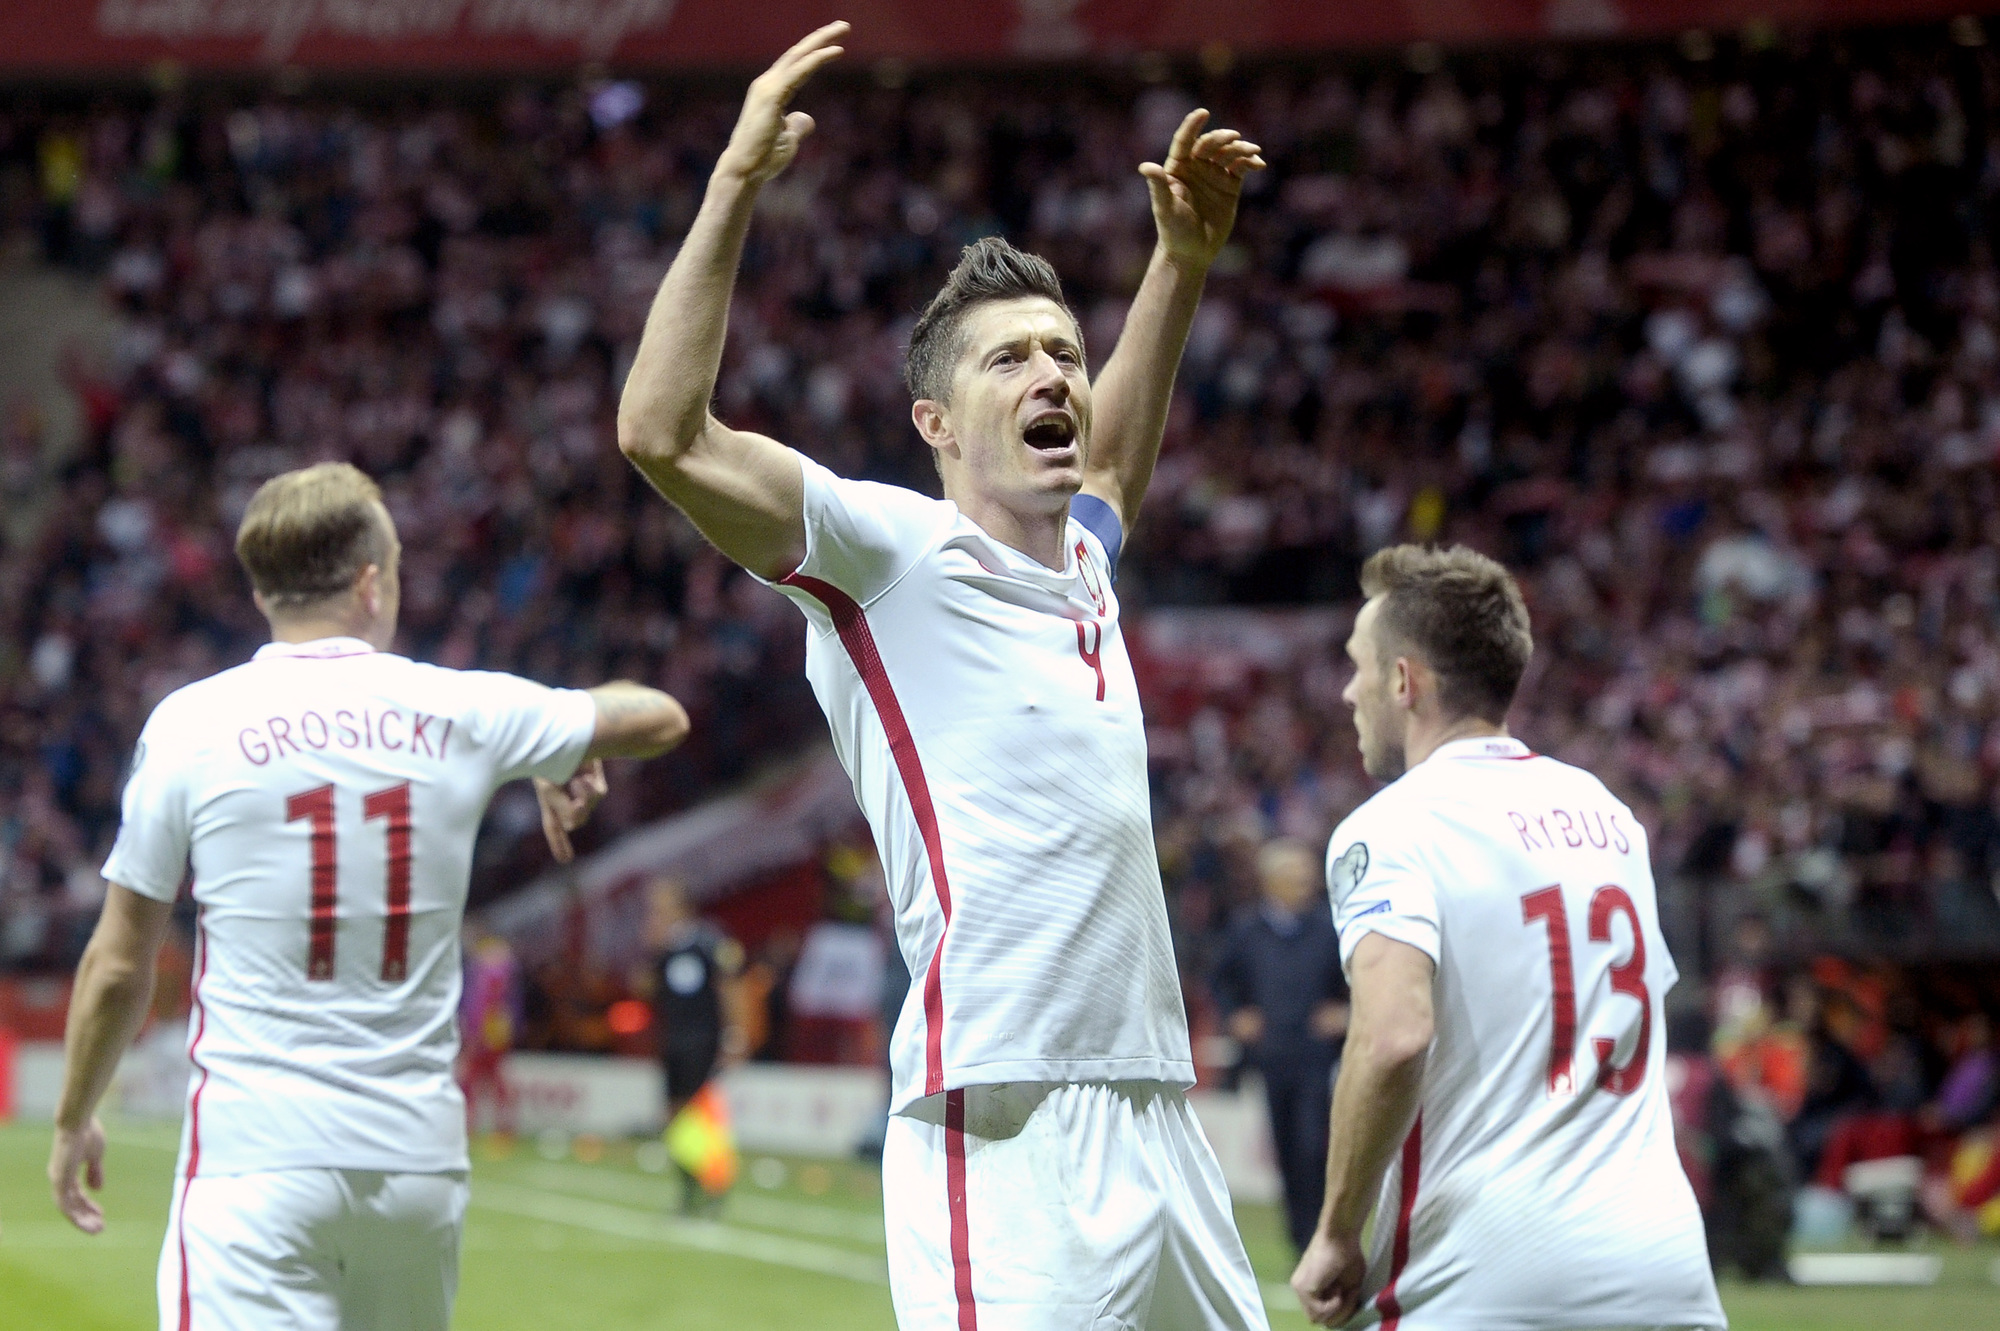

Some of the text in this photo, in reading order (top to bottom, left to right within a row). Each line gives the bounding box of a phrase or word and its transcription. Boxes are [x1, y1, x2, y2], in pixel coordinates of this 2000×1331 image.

[239, 710, 453, 766] GROSICKI
[286, 782, 412, 981] 11
[1507, 808, 1631, 856] RYBUS
[1521, 884, 1651, 1097] 13
